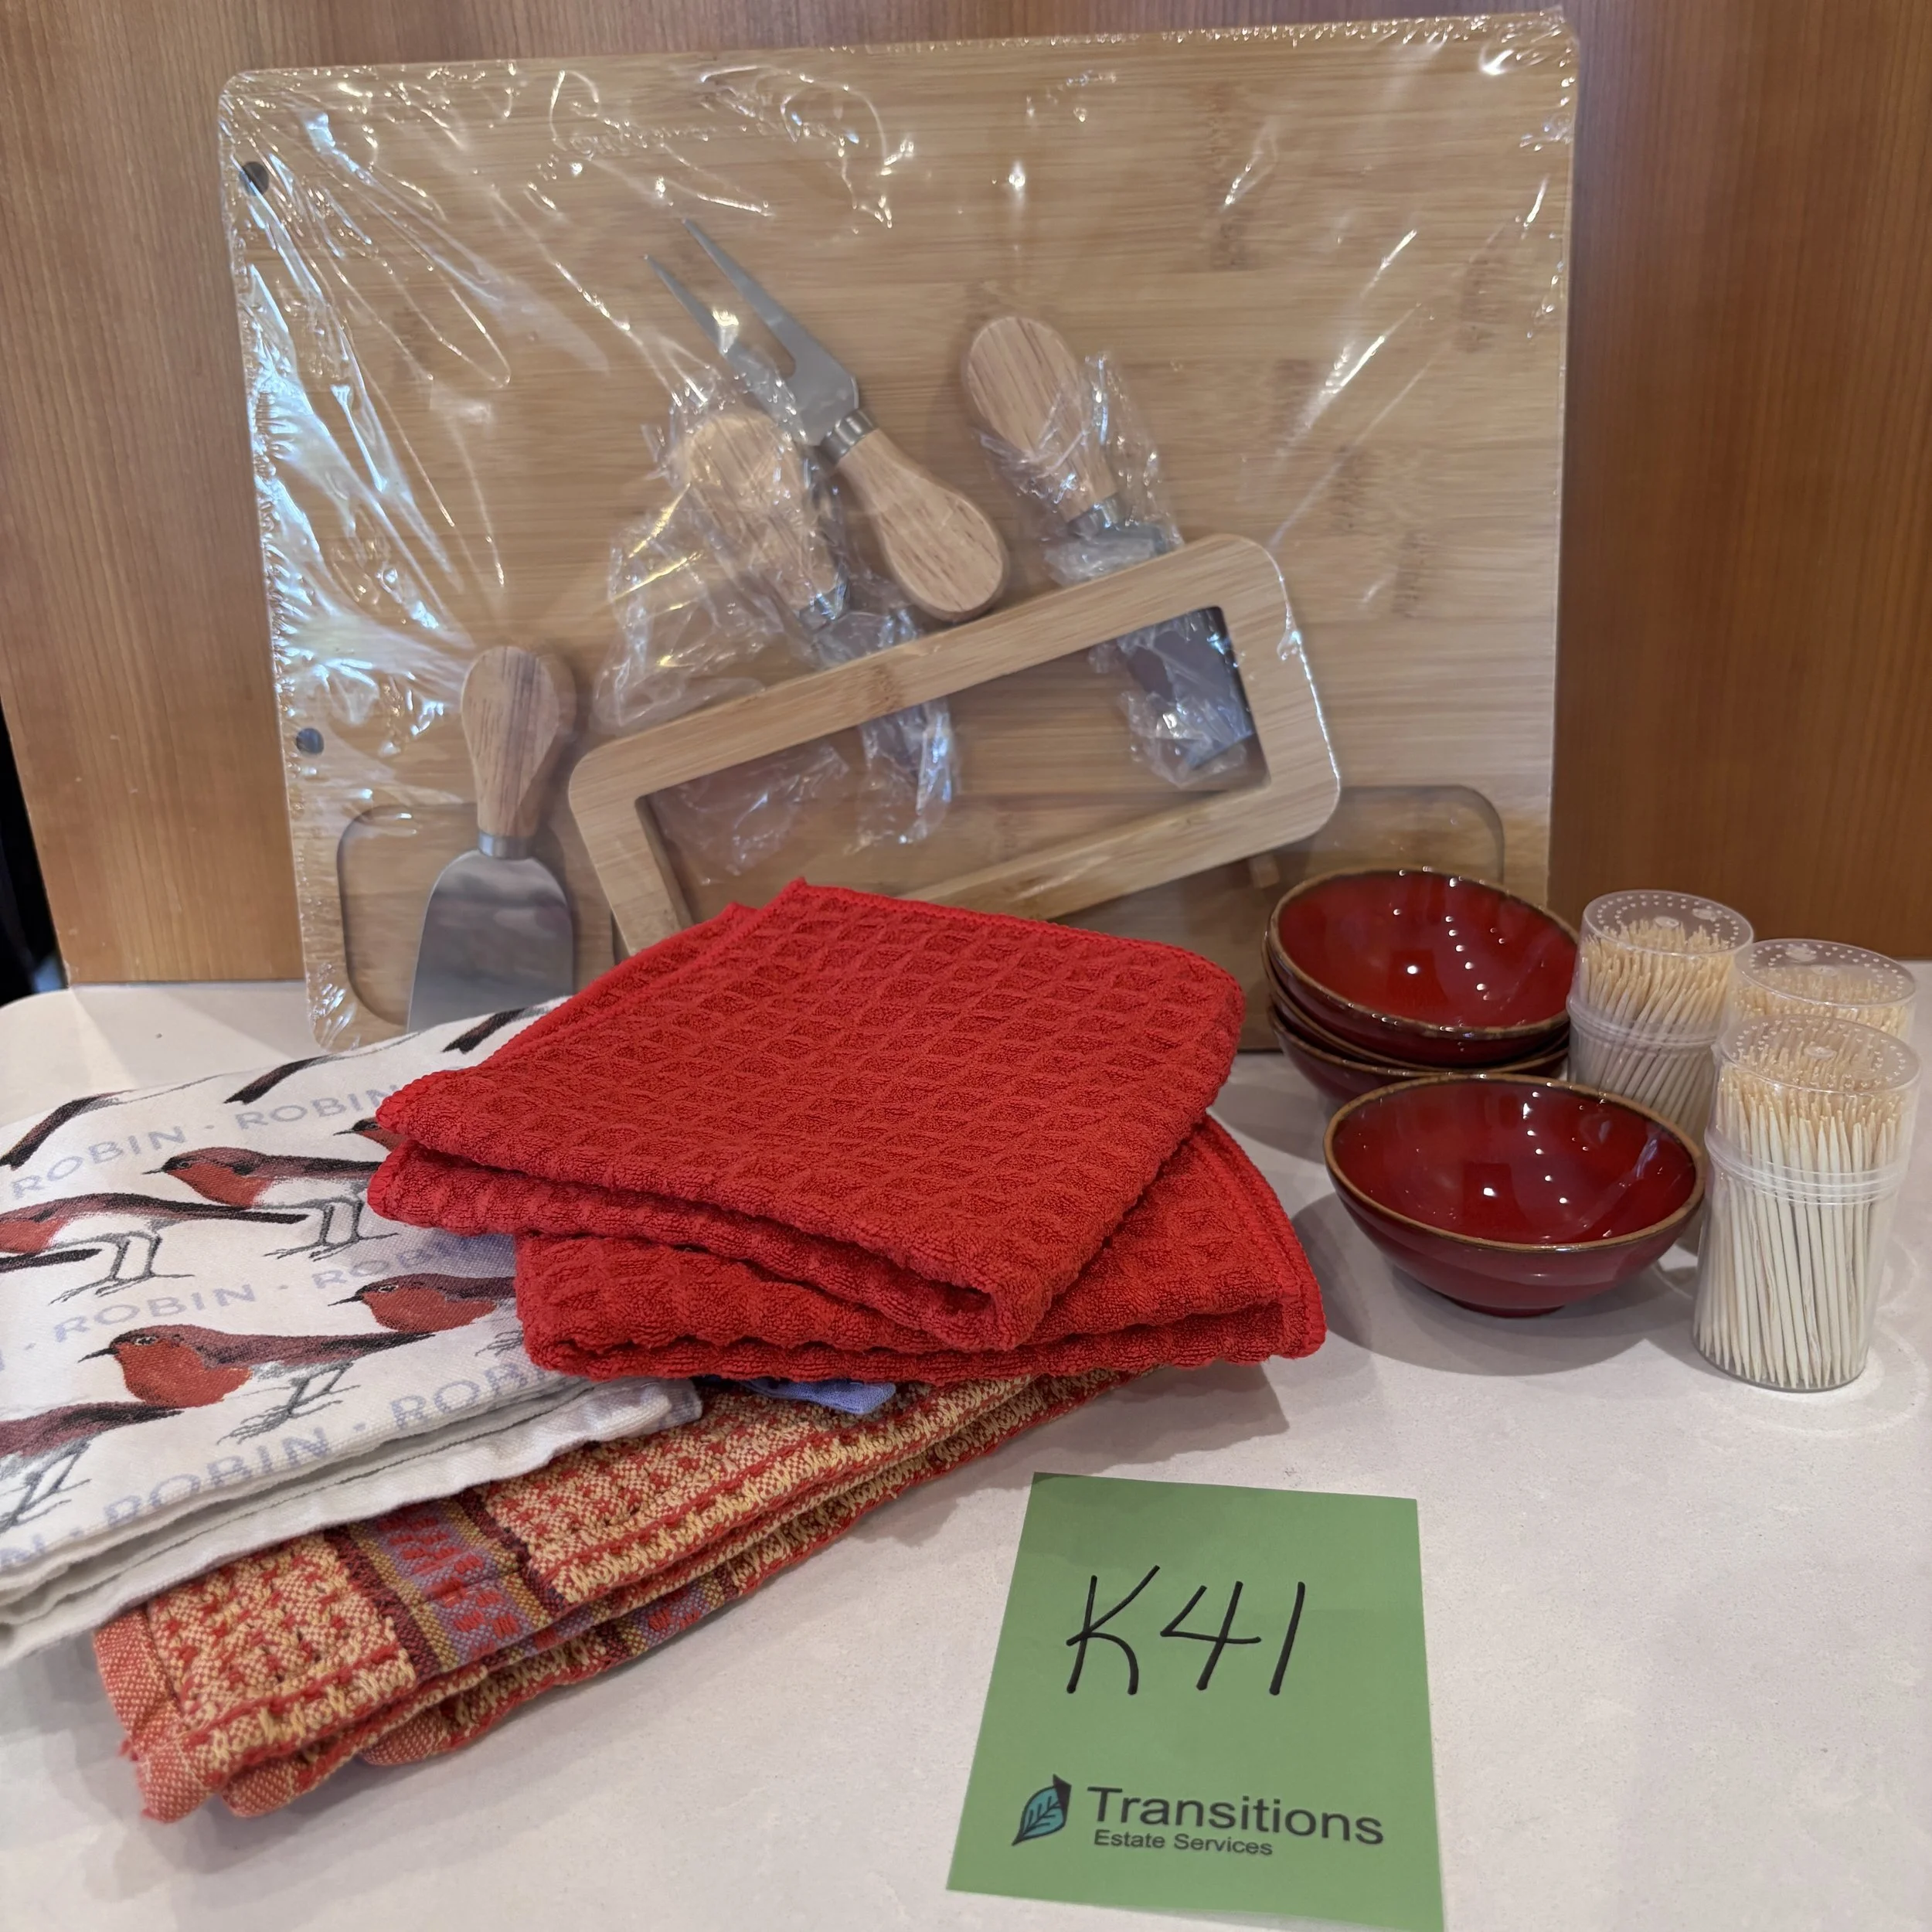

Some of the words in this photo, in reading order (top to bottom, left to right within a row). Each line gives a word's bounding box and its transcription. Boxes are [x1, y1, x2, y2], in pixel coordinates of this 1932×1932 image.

[12, 1126, 186, 1199] ROBIN
[54, 1284, 256, 1342] ROBIN
[1065, 1564, 1305, 1696] K41
[1087, 1786, 1384, 1845] Transitions
[1094, 1828, 1166, 1849] Estate
[1173, 1833, 1274, 1856] Services
